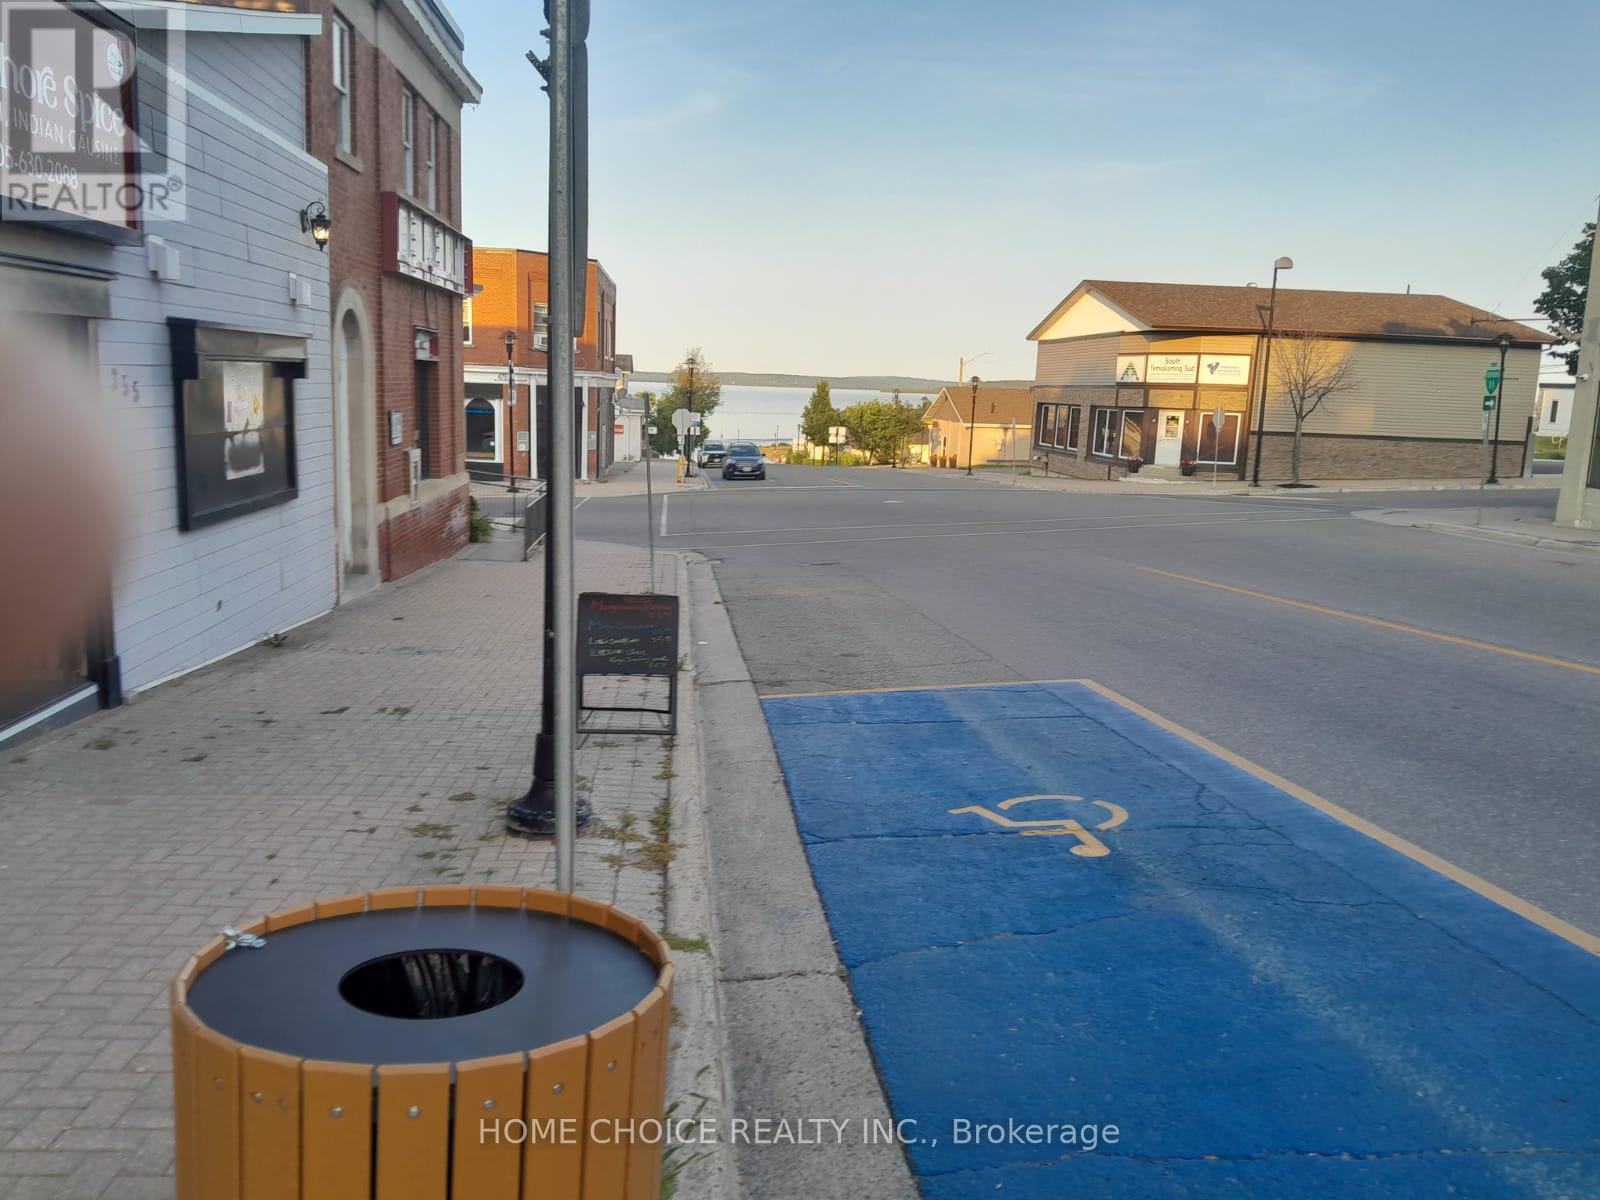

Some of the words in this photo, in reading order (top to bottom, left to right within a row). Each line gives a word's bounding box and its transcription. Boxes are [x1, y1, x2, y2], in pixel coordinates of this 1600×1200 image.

[63, 75, 125, 137] Spice
[14, 108, 64, 145] INDIAN
[68, 129, 120, 165] CAUSINE
[1165, 357, 1181, 365] South
